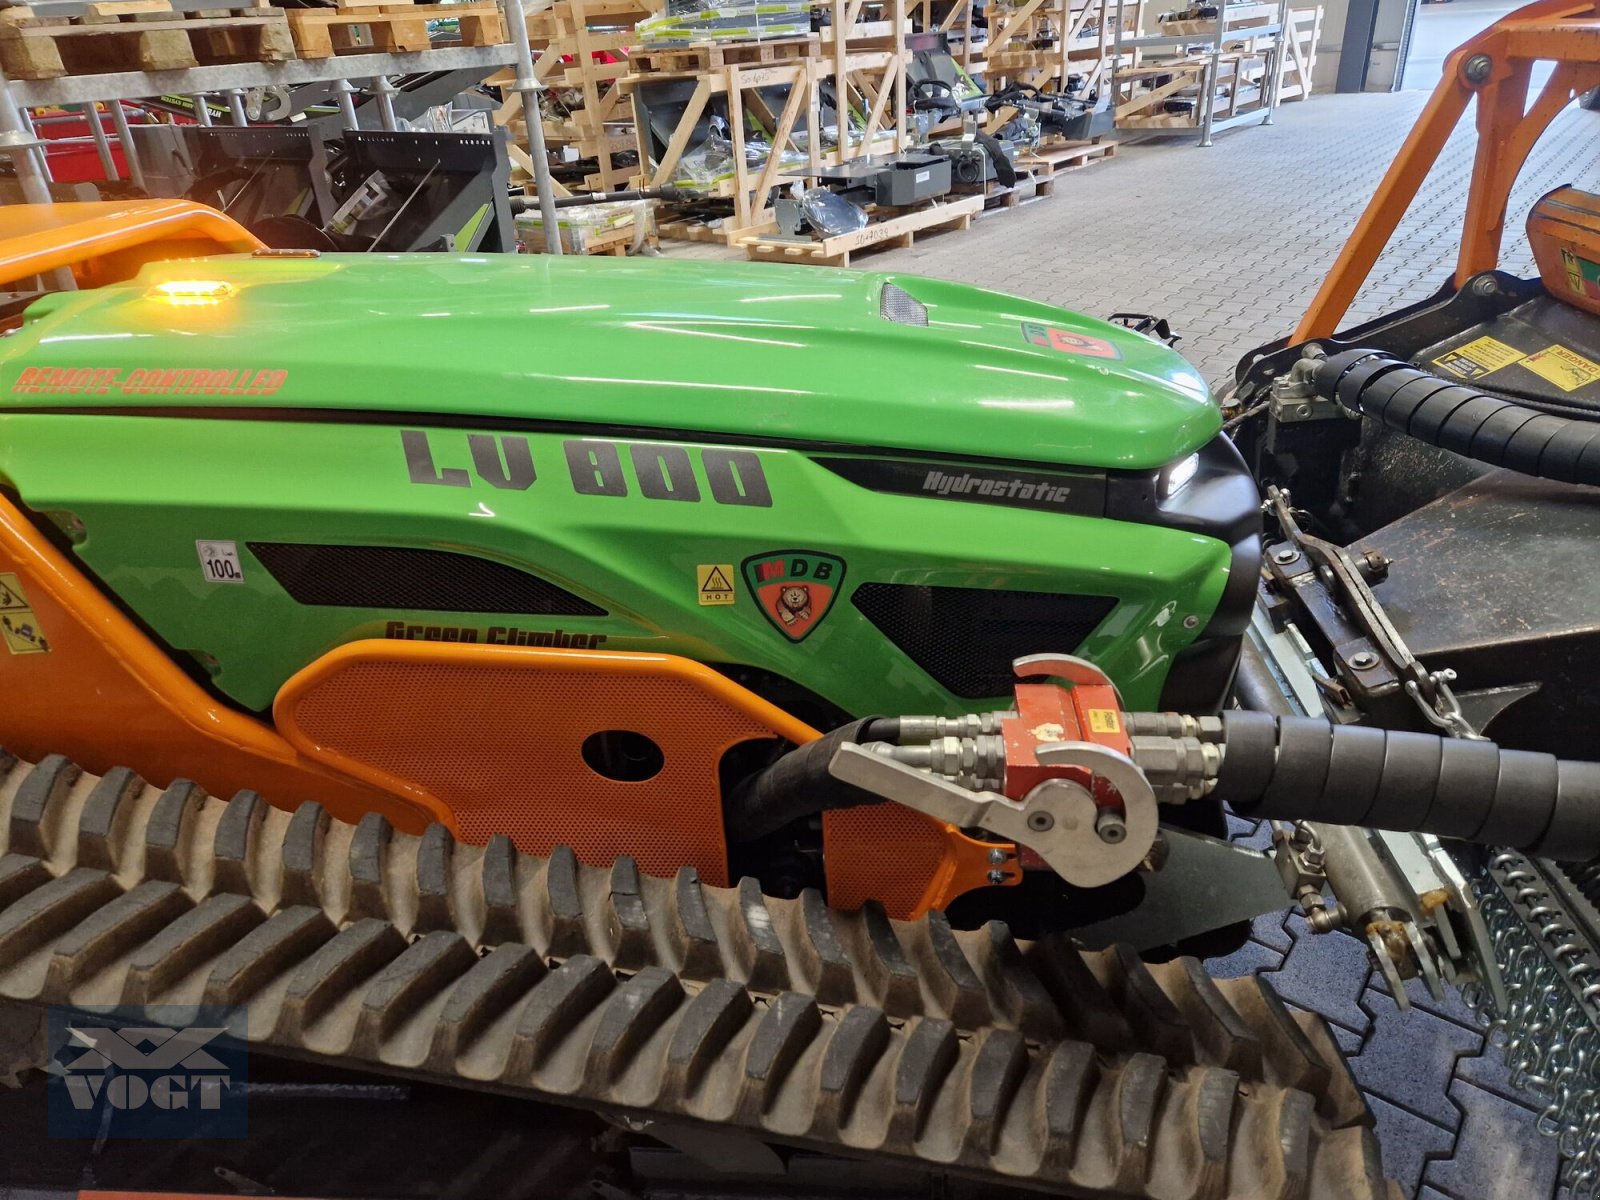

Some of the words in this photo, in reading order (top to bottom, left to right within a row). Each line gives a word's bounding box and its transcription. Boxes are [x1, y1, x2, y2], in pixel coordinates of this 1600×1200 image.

[1557, 348, 1599, 374] DANGER
[12, 367, 288, 396] REMOTE-CONTROLLED
[563, 440, 773, 508] 800
[922, 470, 1071, 503] Hydrostatic
[207, 559, 234, 579] 100
[753, 553, 833, 583] MDB
[705, 592, 729, 601] HOT
[385, 621, 479, 644] Green
[486, 626, 608, 650] Climber
